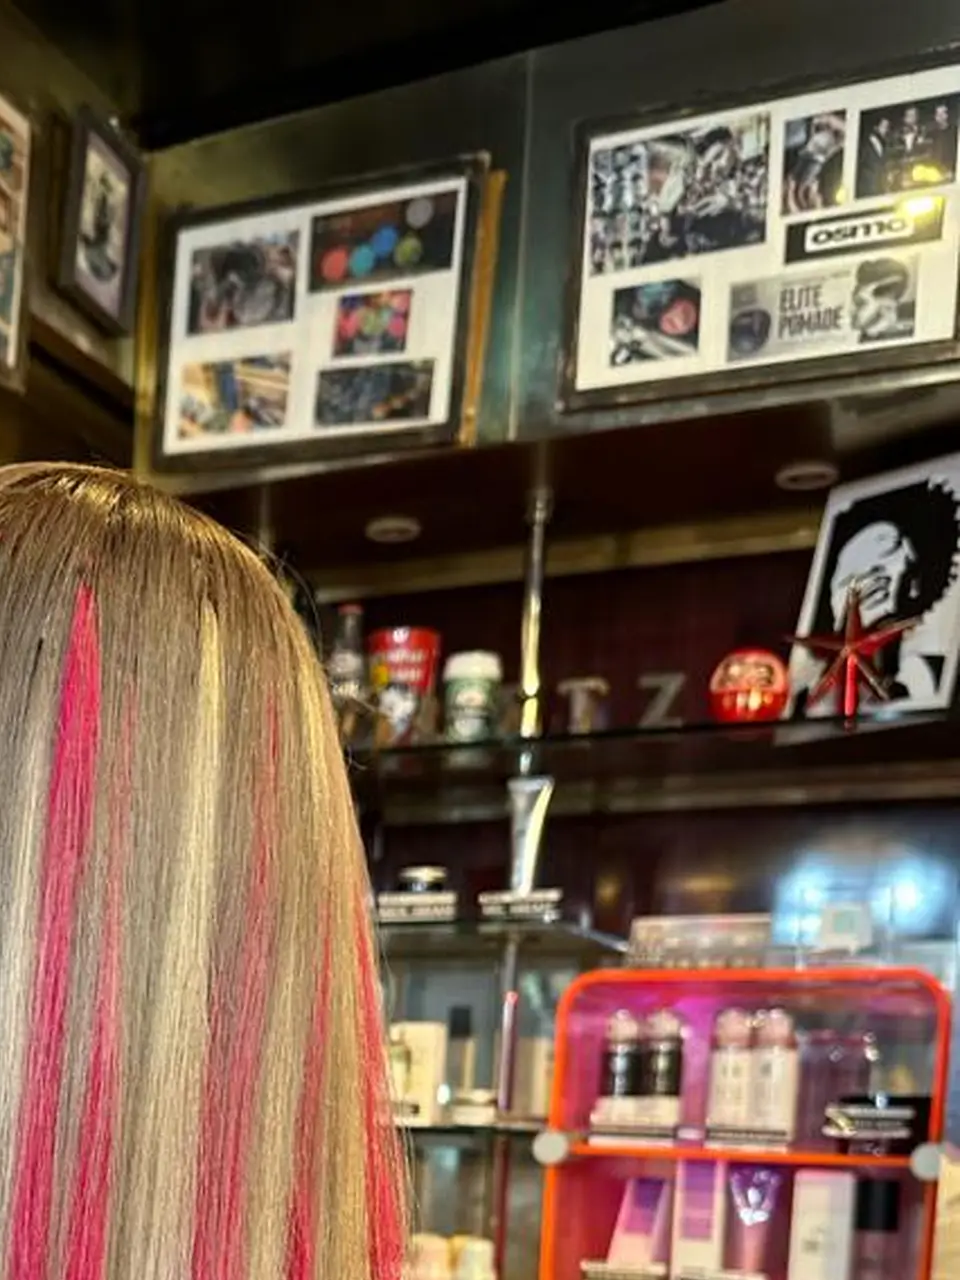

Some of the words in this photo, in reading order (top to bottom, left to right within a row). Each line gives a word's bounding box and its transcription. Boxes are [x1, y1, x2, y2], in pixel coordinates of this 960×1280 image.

[812, 218, 906, 245] osmo
[780, 283, 822, 313] ELITE
[778, 305, 843, 339] POMADE
